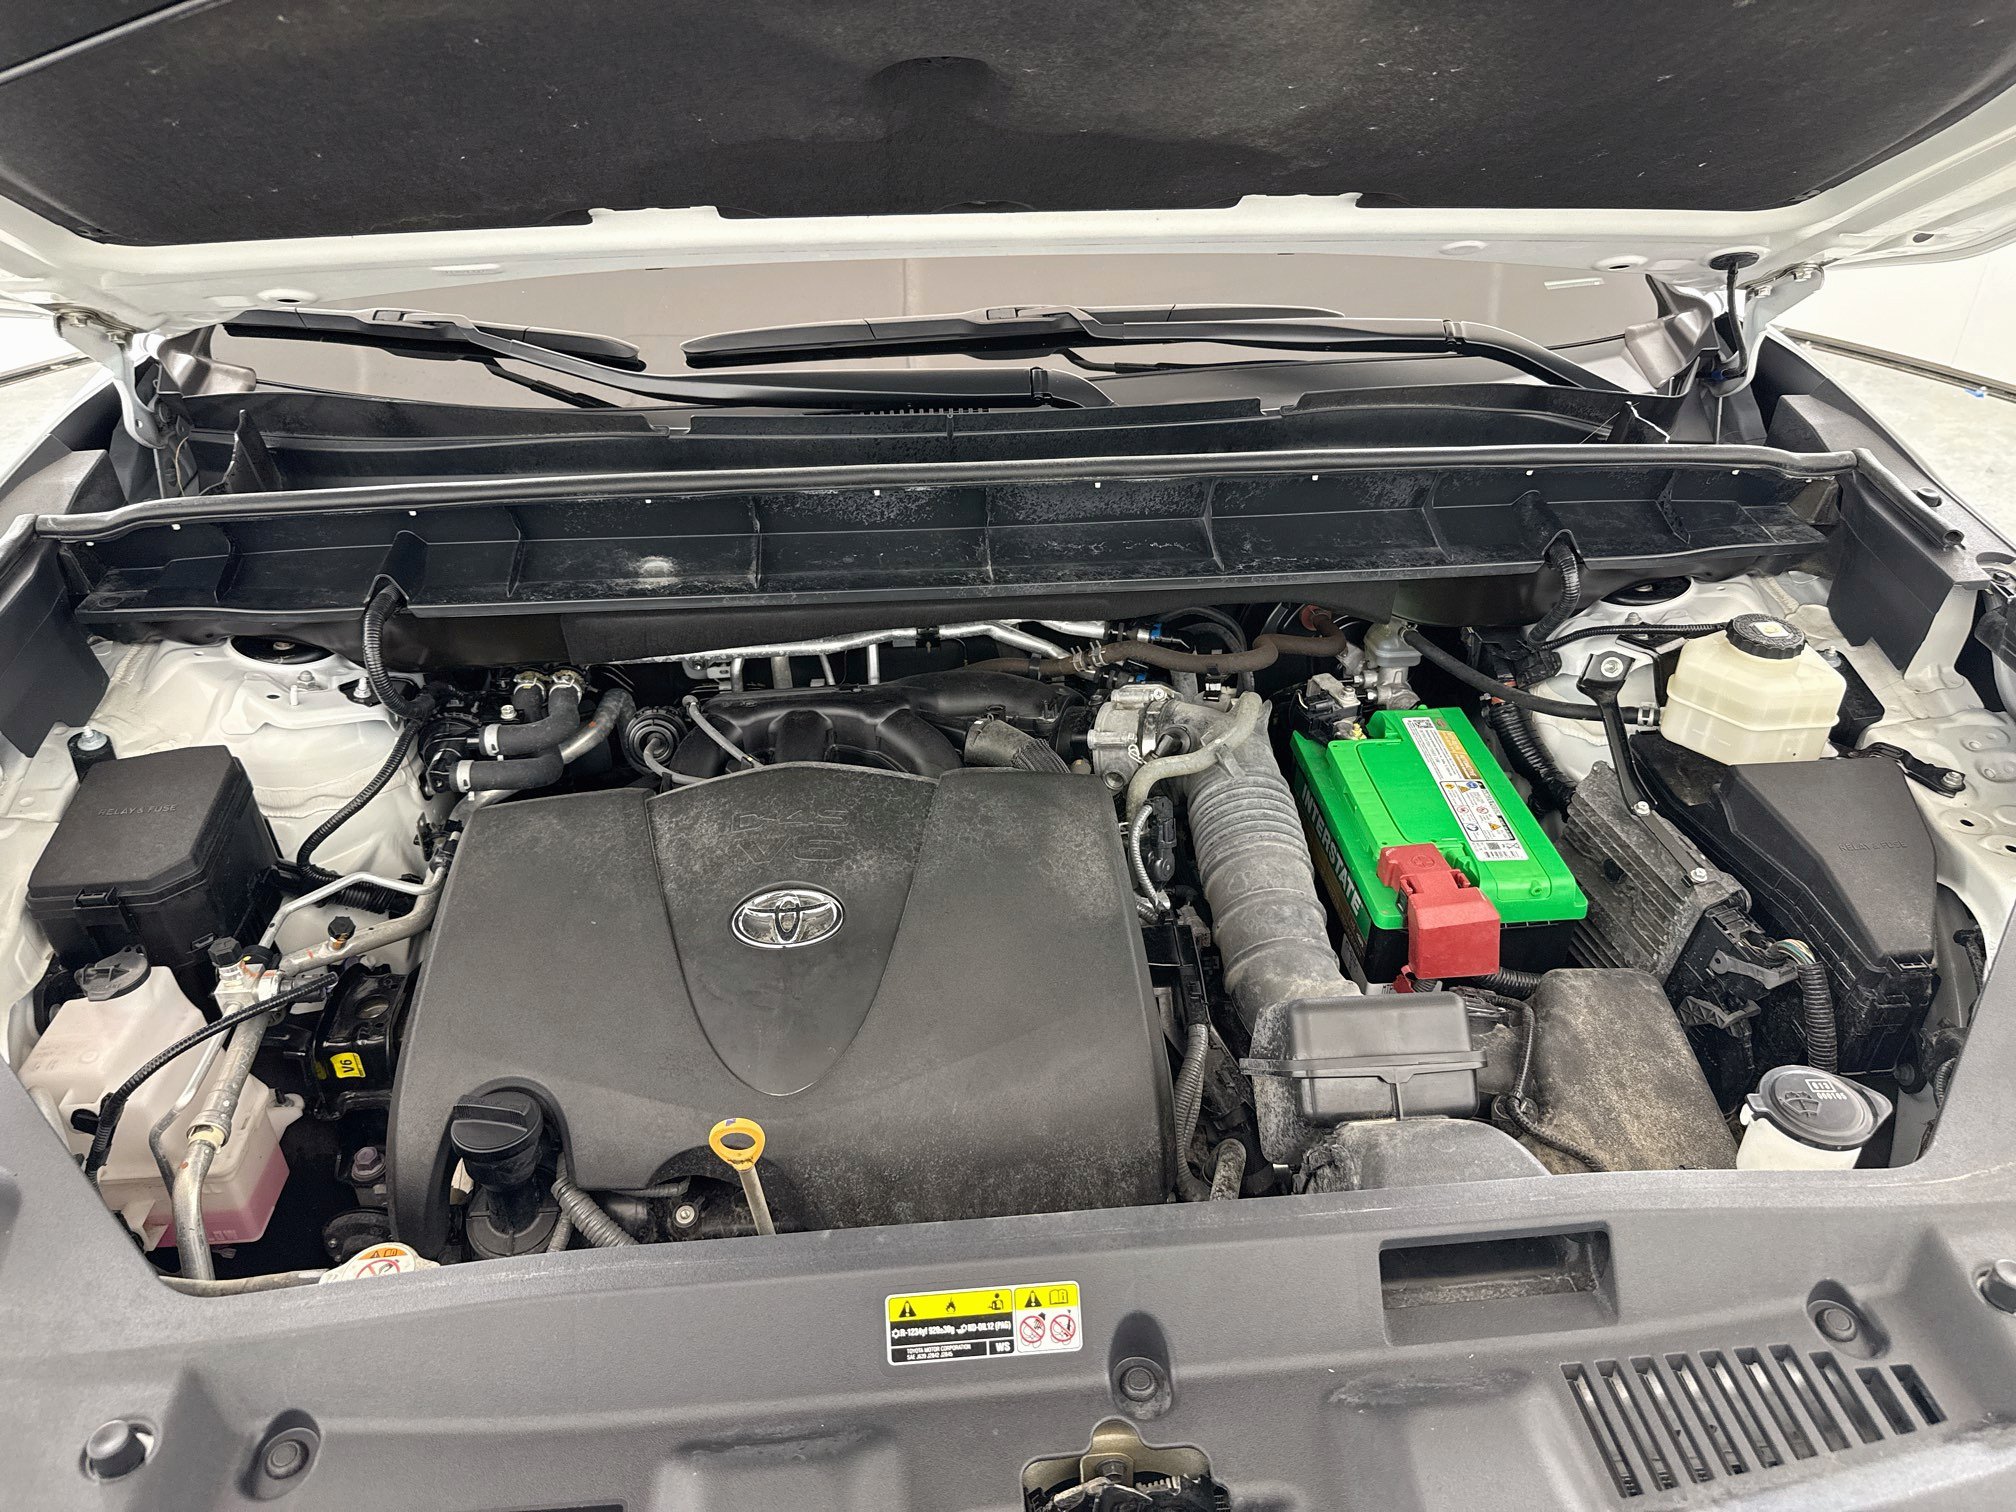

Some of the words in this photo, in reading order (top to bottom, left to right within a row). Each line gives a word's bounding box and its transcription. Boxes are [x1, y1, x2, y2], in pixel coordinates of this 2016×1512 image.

[147, 803, 179, 813] FUSE
[735, 832, 845, 864] V6
[1301, 783, 1362, 916] INTERSTATE
[1879, 840, 1908, 849] FUSE
[340, 1059, 355, 1074] V6
[940, 1343, 972, 1352] CORPORATION
[995, 1341, 1011, 1353] WS
